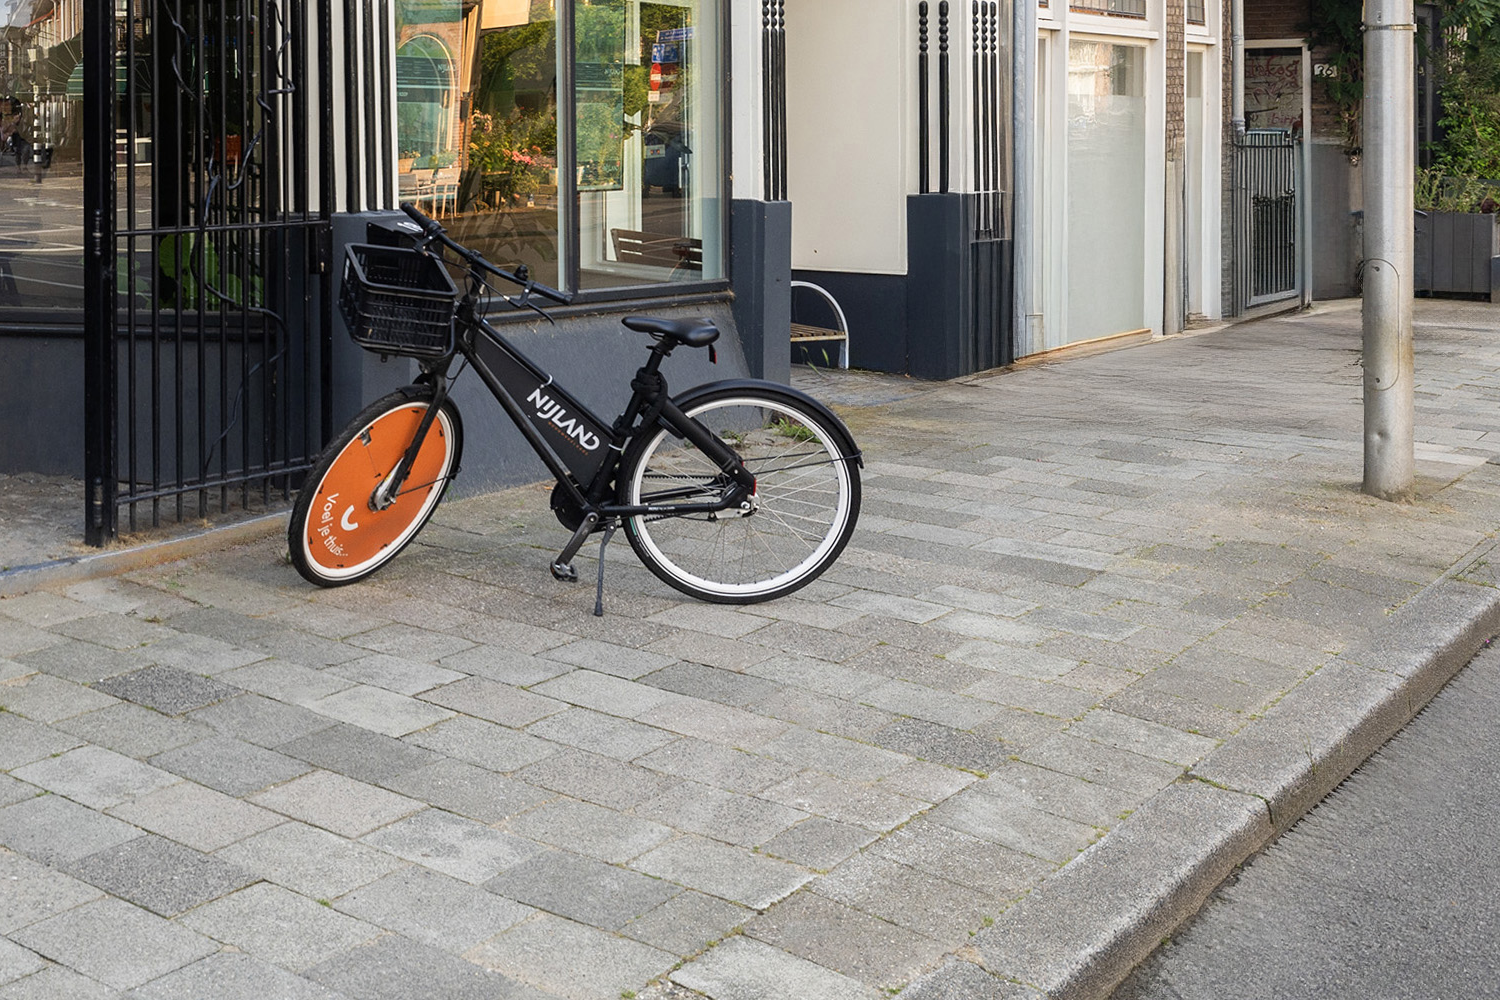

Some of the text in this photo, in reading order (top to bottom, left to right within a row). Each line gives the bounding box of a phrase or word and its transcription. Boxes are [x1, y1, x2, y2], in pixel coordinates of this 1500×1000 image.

[526, 388, 601, 451] NIJLAND
[321, 493, 340, 524] Voel
[317, 523, 332, 537] je
